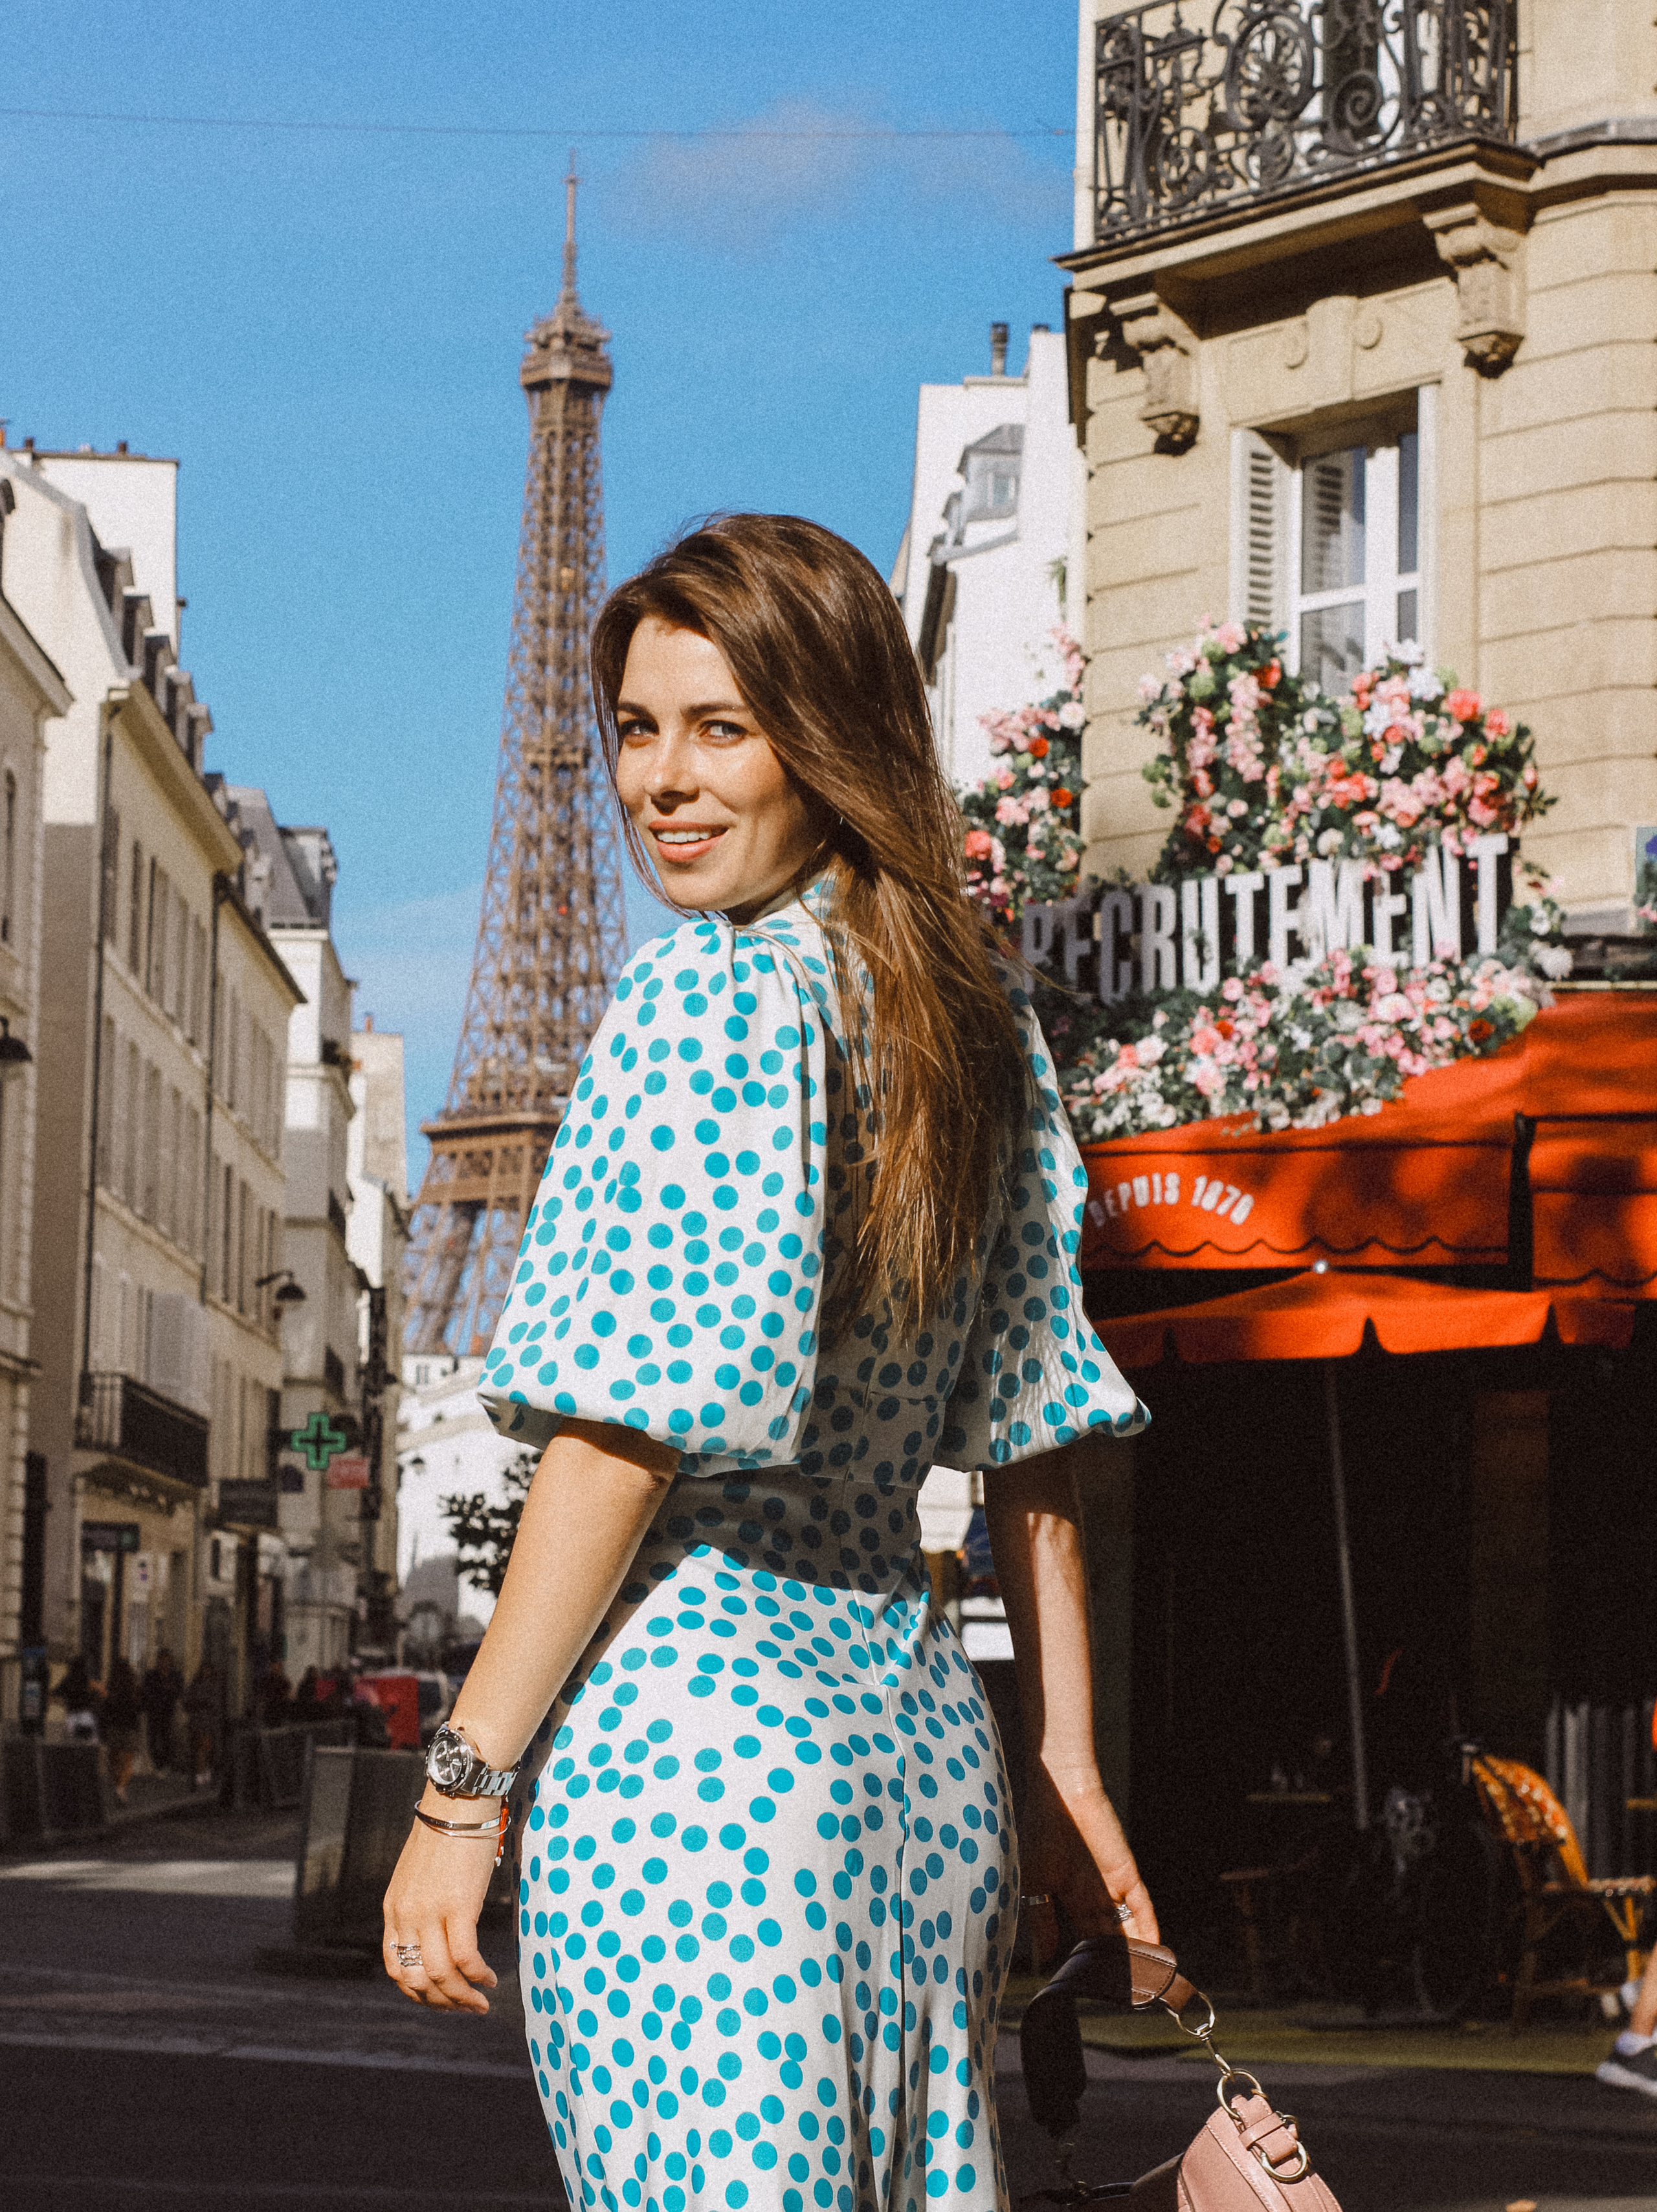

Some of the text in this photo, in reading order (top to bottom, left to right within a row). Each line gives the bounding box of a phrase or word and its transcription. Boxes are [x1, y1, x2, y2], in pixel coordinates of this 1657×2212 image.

[1021, 832, 1509, 1006] RECRUTEMENT
[1087, 1172, 1254, 1227] DEPUIS 1870
